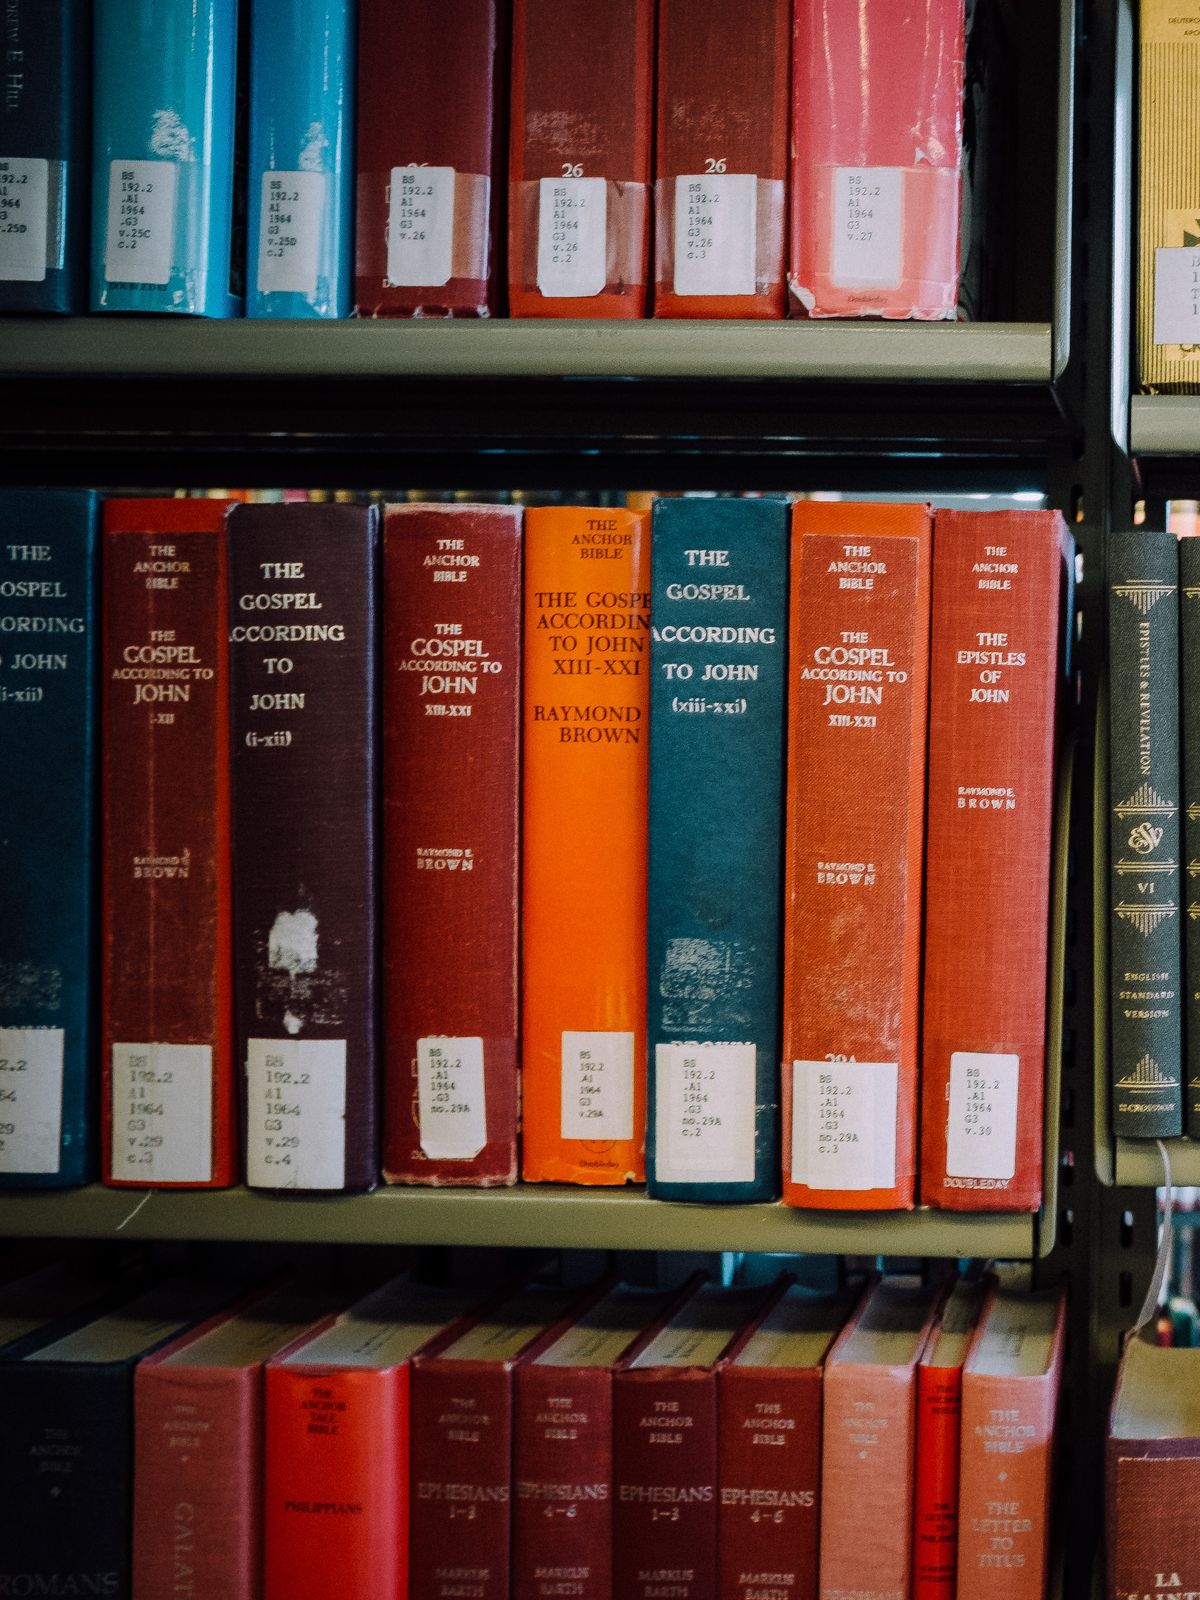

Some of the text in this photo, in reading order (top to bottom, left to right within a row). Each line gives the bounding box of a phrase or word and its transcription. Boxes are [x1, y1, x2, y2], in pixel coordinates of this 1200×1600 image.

[562, 164, 584, 178] 26
[705, 158, 727, 174] 26
[122, 183, 153, 192] 192.2
[689, 195, 719, 203] 192.2
[689, 217, 712, 225] 1964
[119, 229, 151, 238] v.25C
[587, 520, 617, 530] THE
[436, 540, 464, 550] THE
[572, 534, 632, 545] ANCHOR
[6, 545, 51, 560] THE
[149, 546, 176, 556] THE
[580, 549, 623, 559] BIBLE
[843, 546, 871, 557] THE
[984, 547, 1007, 556] THE
[423, 556, 480, 566] ANCHOR
[685, 550, 729, 566] THE
[134, 562, 190, 572] ANCHOR
[260, 563, 305, 579] THE
[828, 562, 886, 574] ANCHOR
[972, 563, 1019, 574] ANCHOR
[433, 571, 467, 582] BIBLE
[146, 578, 179, 589] BIBLE
[839, 578, 874, 590] BIBLE
[979, 580, 1011, 590] BIBLE
[666, 584, 750, 601] GOSPEL
[239, 593, 322, 610] GOSPEL
[535, 592, 576, 608] THE
[435, 624, 463, 635] THE
[149, 631, 176, 641] THE
[840, 632, 868, 643] THE
[976, 633, 1008, 646] THE
[411, 639, 489, 657] GOSPEL
[549, 636, 644, 654] TO JOHN
[123, 646, 201, 663] GOSPEL
[814, 647, 895, 667] GOSPEL
[957, 651, 1026, 666] EPISTLES
[11, 654, 68, 669] JOHN
[263, 658, 293, 674] TO
[399, 660, 502, 673] ACCORDING TO
[553, 660, 640, 675] XIII-XXI
[112, 669, 214, 679] ACCORDING TO
[662, 664, 758, 681] TO JOHN
[801, 669, 907, 683] ACCORDING TO
[980, 670, 1002, 683] OF
[420, 676, 478, 695] JOHN
[134, 685, 190, 704] JOHN
[823, 685, 883, 705] JOHN
[969, 690, 1009, 703] JOHN
[1140, 623, 1151, 775] EPISTLES & REVELATION
[250, 694, 305, 710] JOHN
[534, 706, 641, 721] RAYMOND
[560, 728, 640, 743] BROWN
[958, 787, 1006, 796] RAYMOND
[958, 798, 1016, 809] BROWN
[417, 859, 473, 871] BROWN
[817, 873, 876, 885] BROWN
[1137, 883, 1155, 894] VI
[1124, 973, 1169, 981] ENGLISH
[1119, 991, 1174, 1000] STANDARD
[1124, 1010, 1169, 1019] VERSION
[265, 1071, 310, 1084] 192.2
[966, 1080, 1000, 1089] 192.2
[820, 1087, 852, 1095] 192.2
[130, 1104, 163, 1115] 1964
[431, 1104, 470, 1112] no.29A
[682, 1117, 721, 1125] no.29A
[265, 1155, 291, 1165] c.4
[944, 1178, 1010, 1189] DOUBLEDAY
[654, 1402, 678, 1412] THE
[755, 1404, 781, 1414] THE
[990, 1410, 1020, 1421] THE
[640, 1417, 693, 1427] ANCHOR
[743, 1419, 795, 1429] ANCHOR
[976, 1425, 1036, 1437] ANCHOR
[649, 1433, 682, 1443] BIBLE
[753, 1434, 785, 1445] BIBLE
[984, 1441, 1024, 1453] BIBLE
[418, 1482, 509, 1501] EPHESIANS
[518, 1481, 609, 1500] EPHESIANS
[620, 1485, 713, 1502] EPHESIANS
[721, 1488, 814, 1506] EPHESIANS
[991, 1538, 1013, 1550] TO
[739, 1573, 795, 1585] MARKUS
[1155, 1573, 1182, 1588] LA
